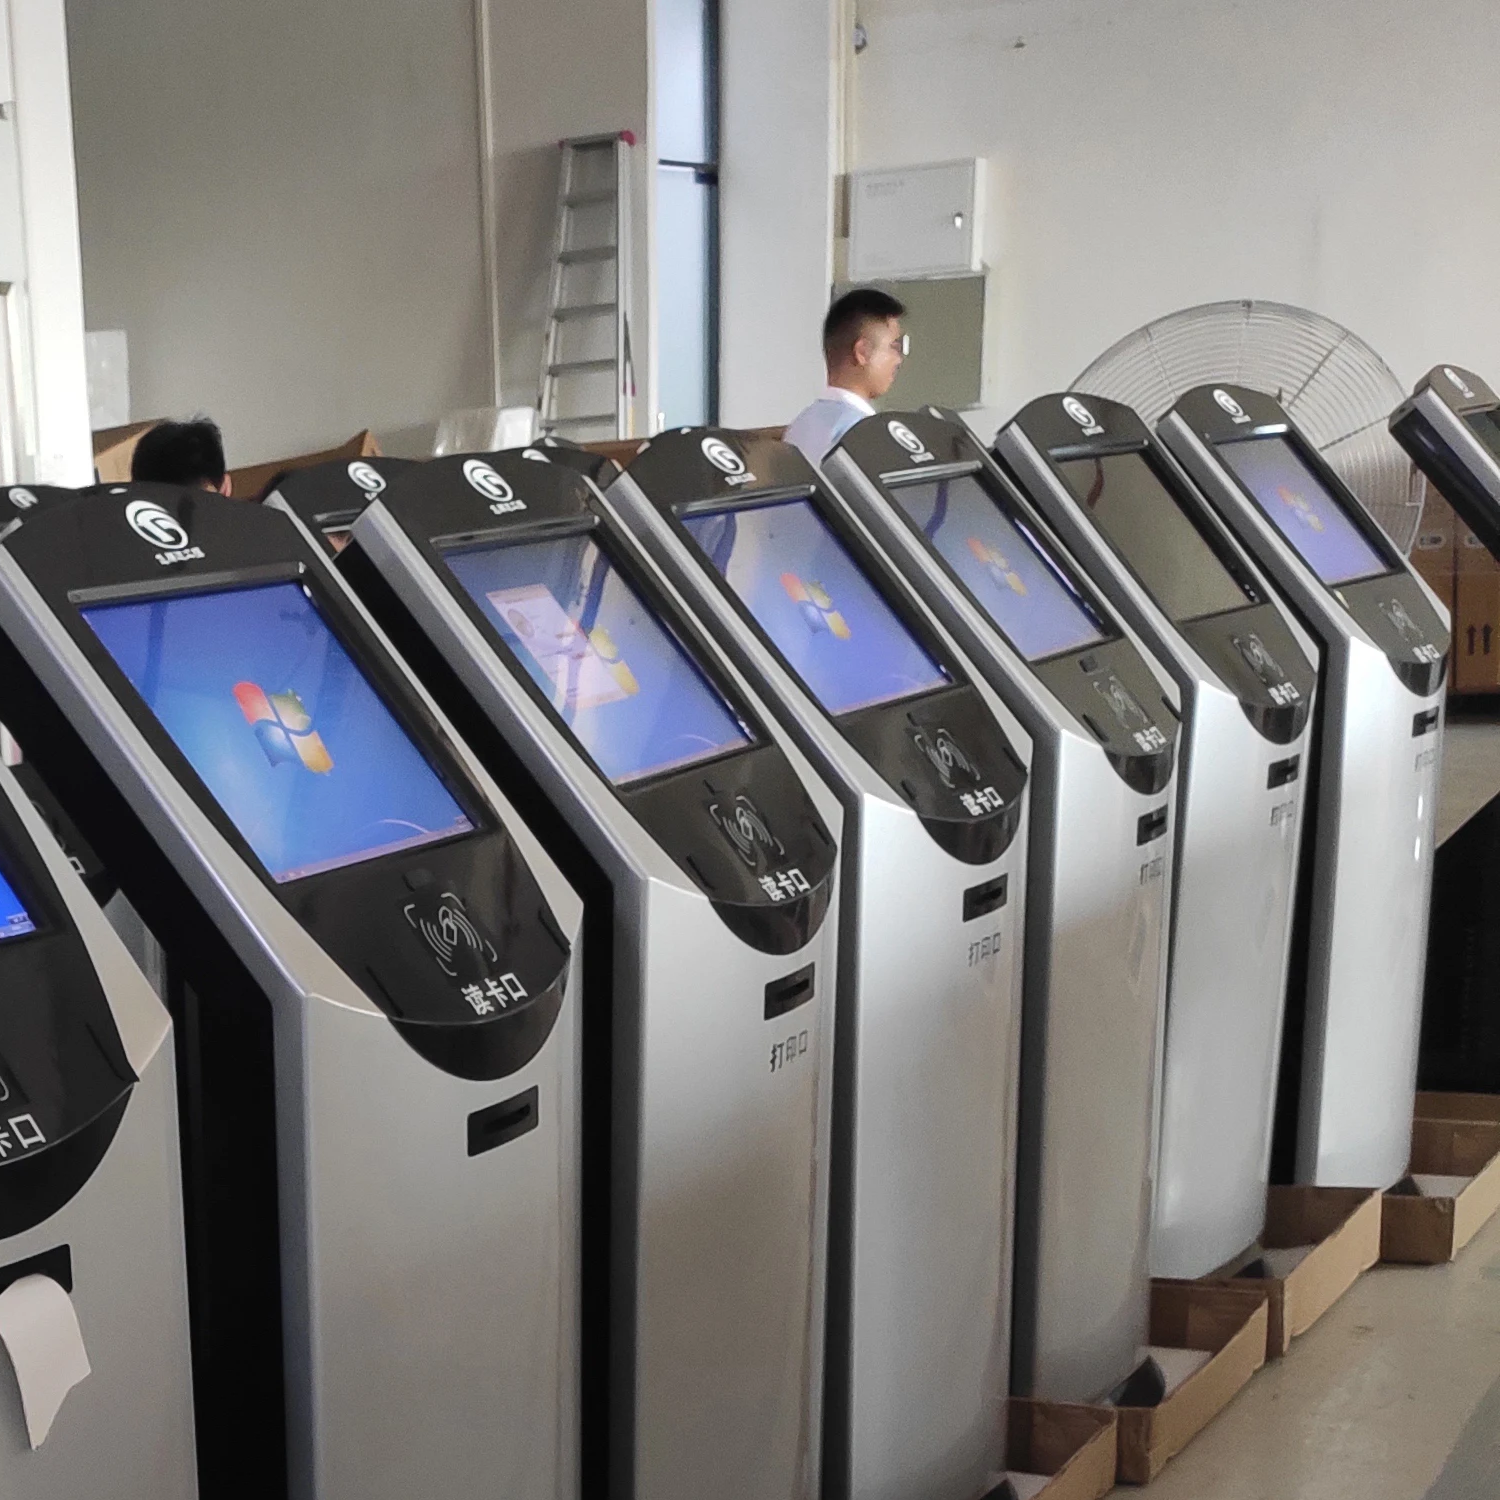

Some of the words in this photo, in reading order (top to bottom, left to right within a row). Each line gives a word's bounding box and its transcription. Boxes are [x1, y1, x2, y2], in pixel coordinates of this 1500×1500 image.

[758, 868, 811, 901] 读卡口
[461, 973, 529, 1015] 读卡口
